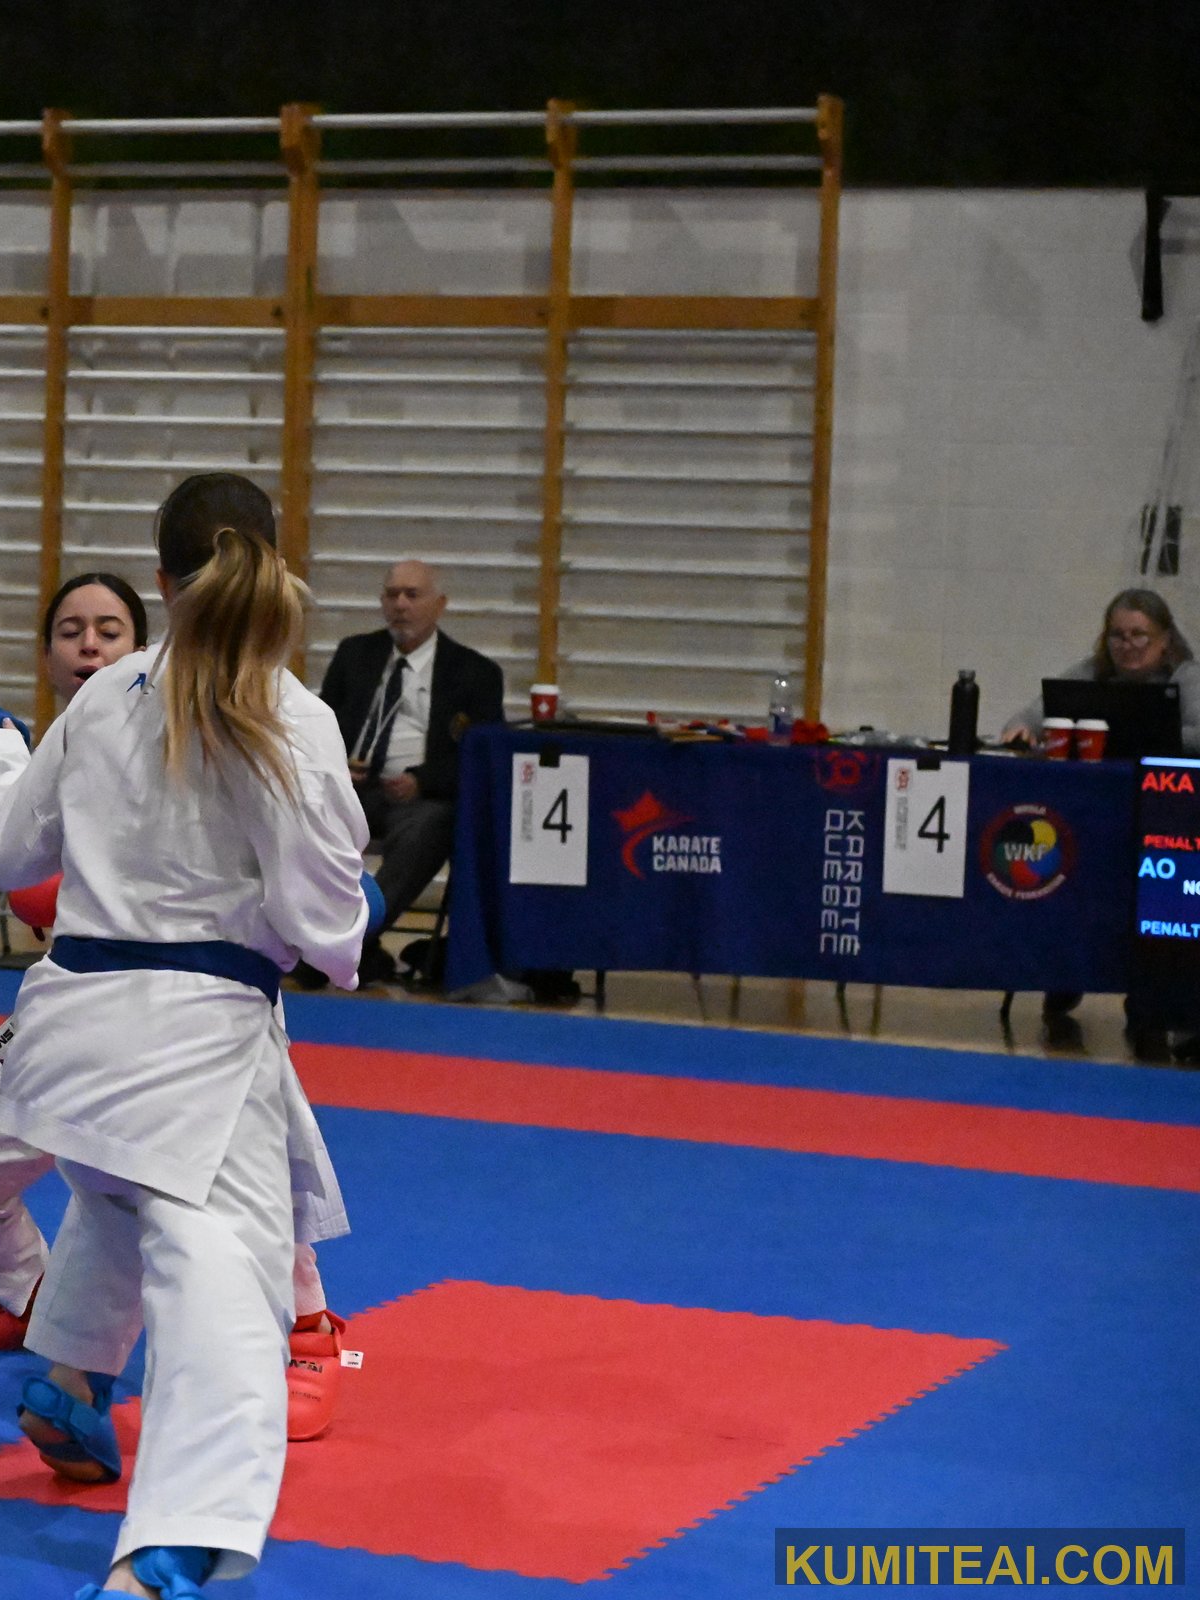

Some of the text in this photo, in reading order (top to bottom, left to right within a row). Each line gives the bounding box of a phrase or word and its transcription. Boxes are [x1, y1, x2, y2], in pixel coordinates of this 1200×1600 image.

[1141, 771, 1195, 793] AKA
[542, 788, 573, 843] 4
[918, 795, 950, 853] 4
[653, 836, 721, 854] KARATE
[1003, 842, 1047, 862] WKF
[653, 854, 722, 873] CANADA
[1138, 857, 1176, 879] AO
[1140, 920, 1200, 938] PENALT
